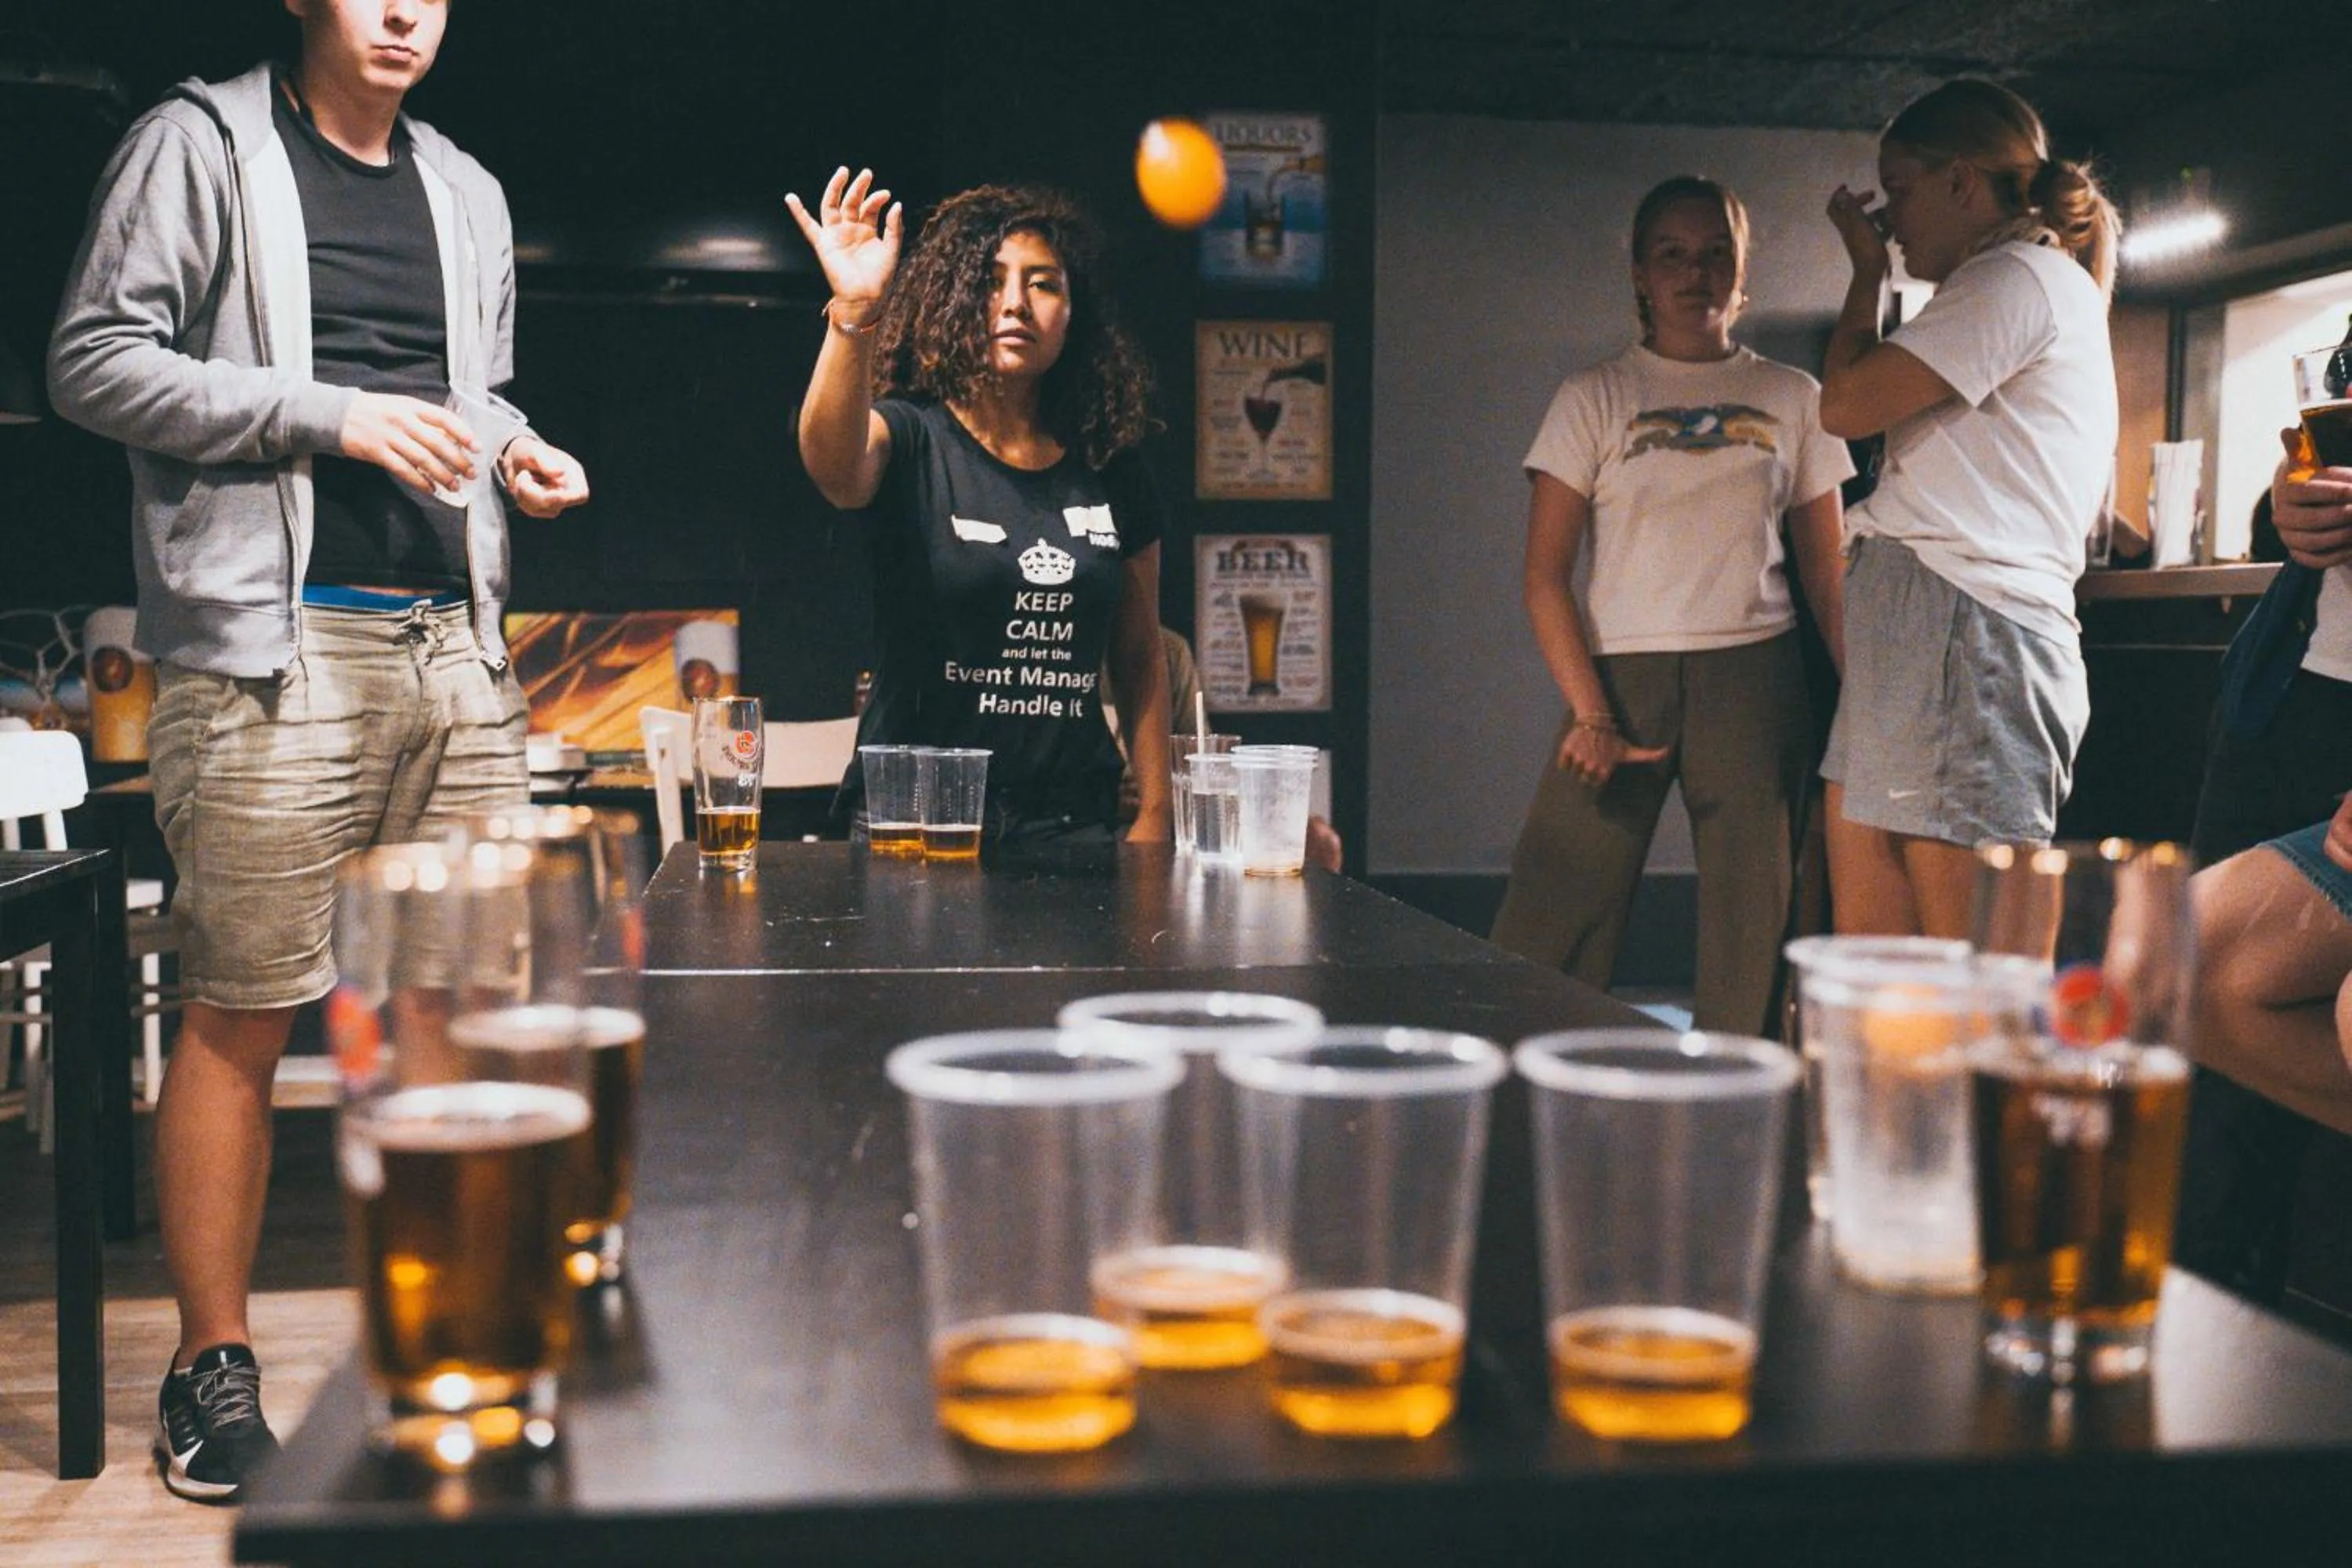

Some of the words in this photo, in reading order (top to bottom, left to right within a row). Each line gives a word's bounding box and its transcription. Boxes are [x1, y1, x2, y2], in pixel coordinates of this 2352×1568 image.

[1216, 550, 1310, 572] BEER
[1014, 591, 1073, 612] KEEP
[1006, 619, 1073, 641] CALM
[1002, 646, 1027, 659] and
[1031, 648, 1048, 660] let
[1051, 648, 1072, 661] the
[945, 661, 1013, 685] Event
[978, 692, 1063, 717] Handle
